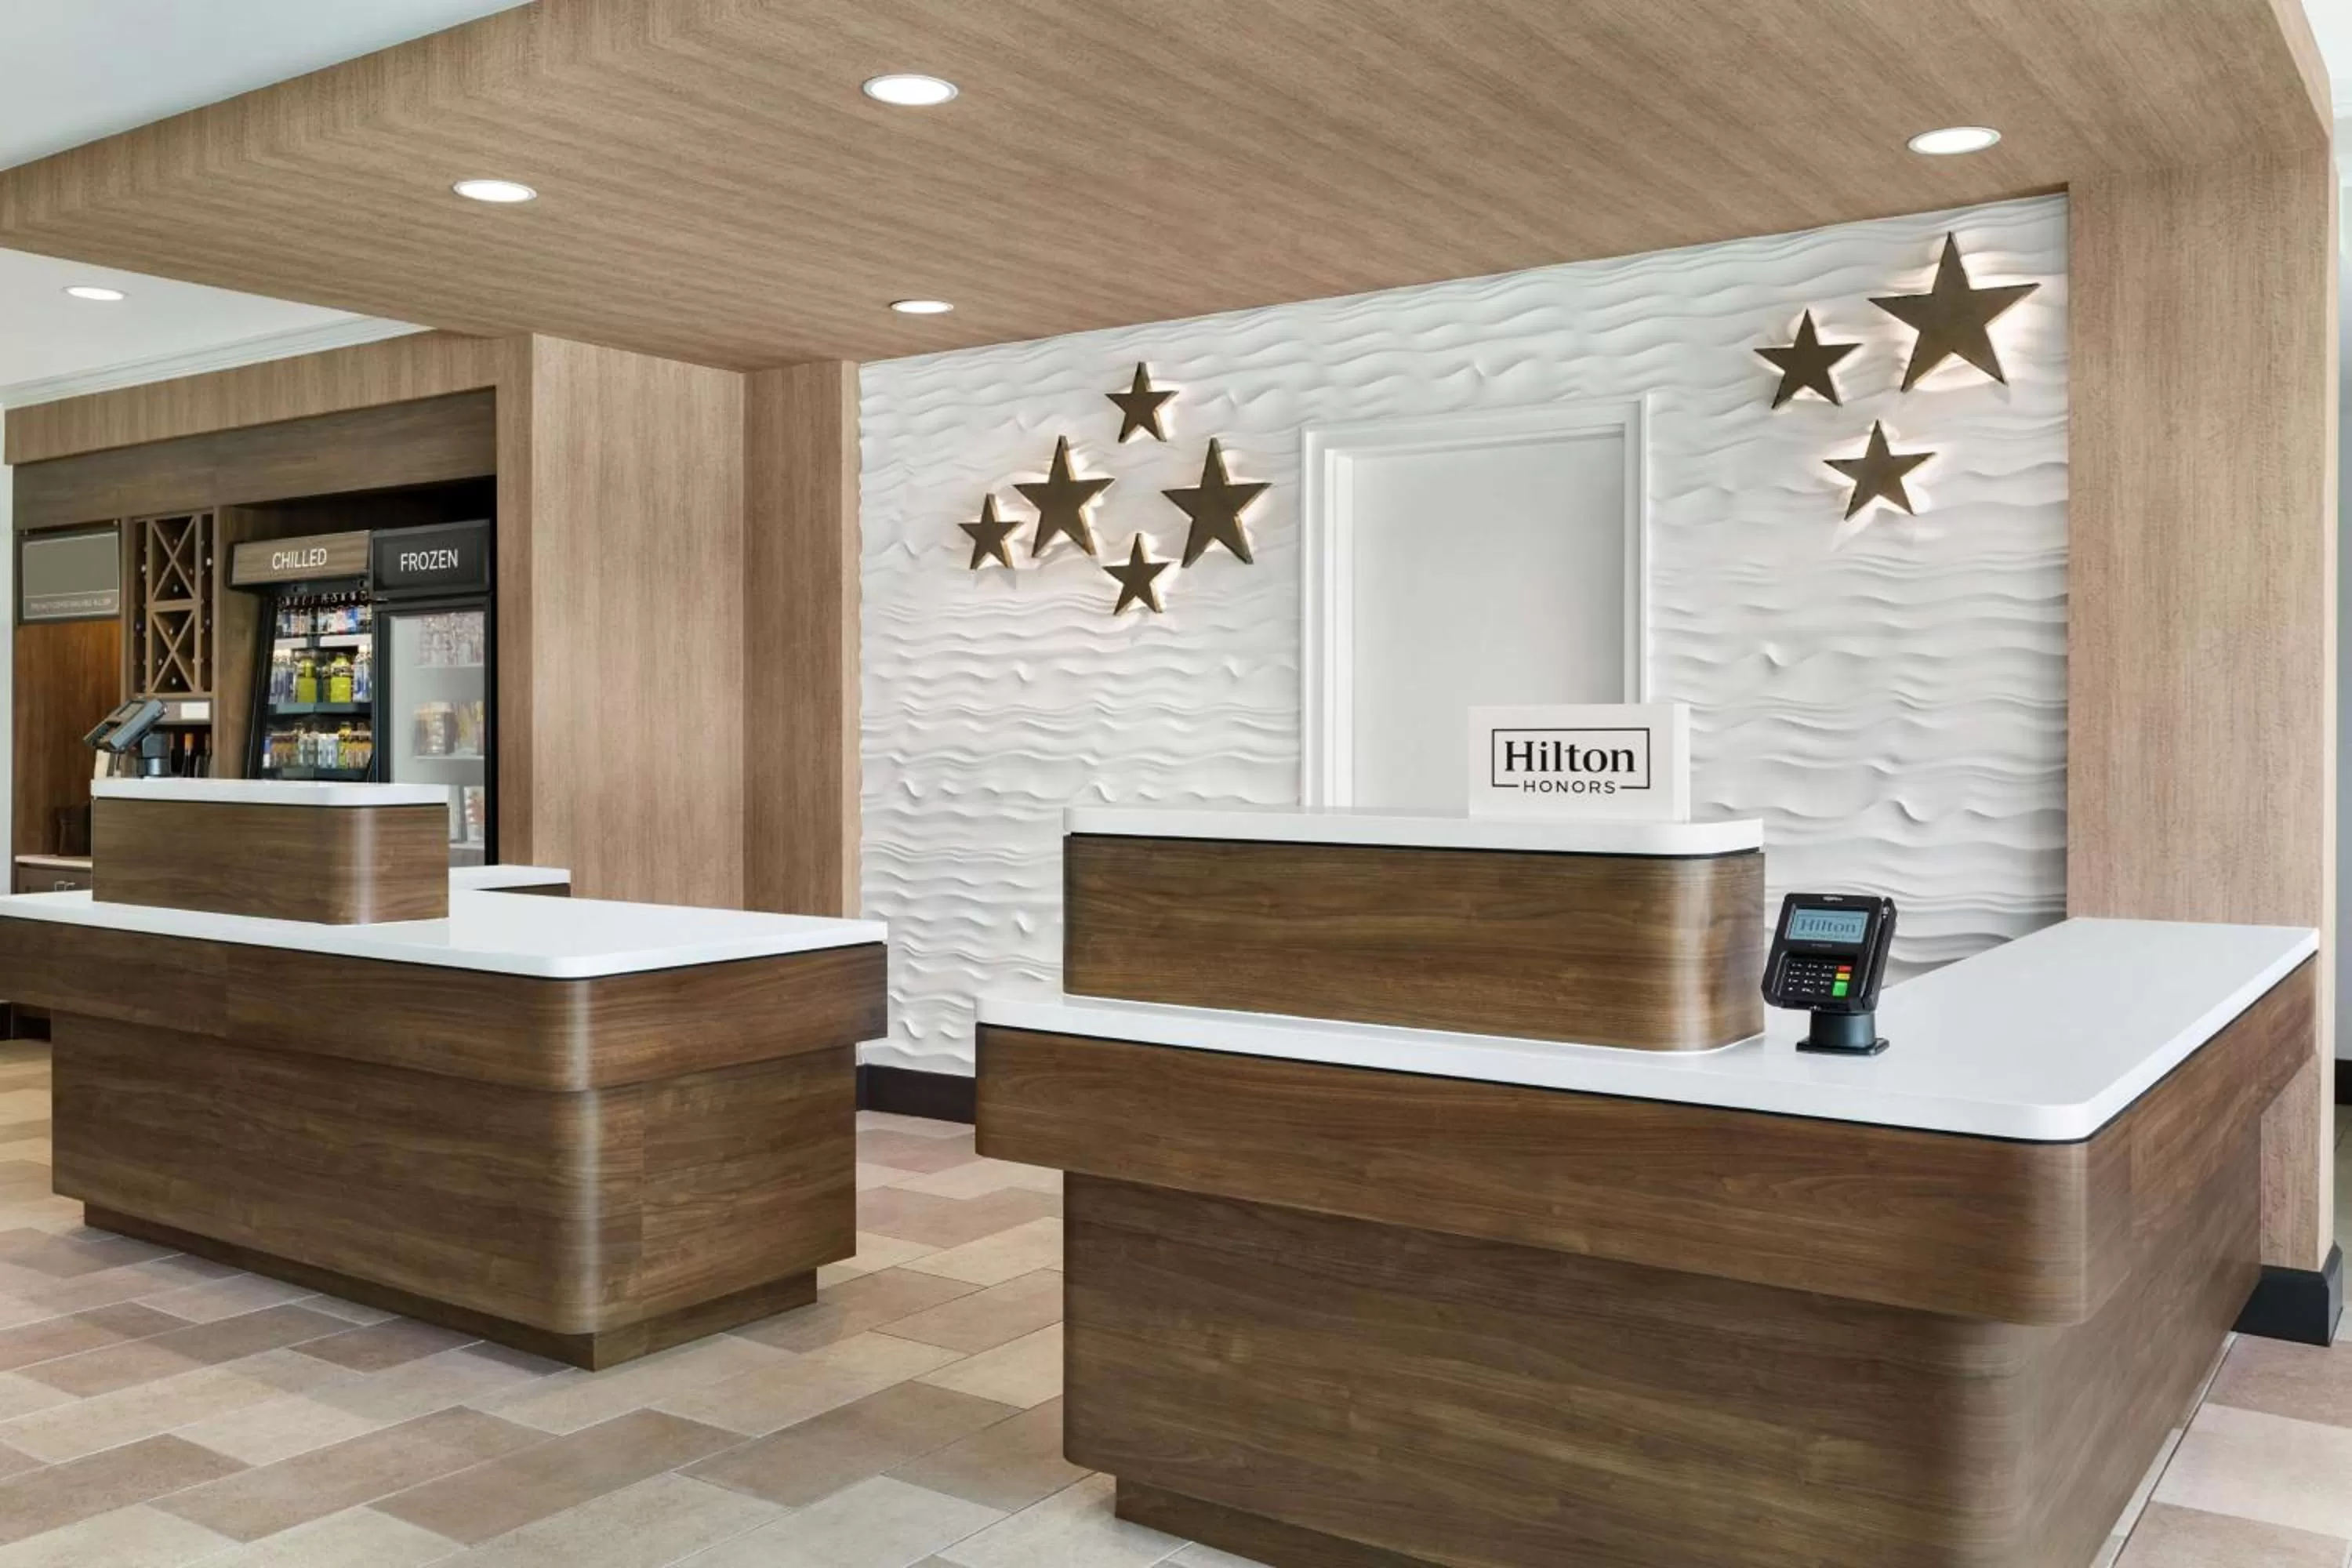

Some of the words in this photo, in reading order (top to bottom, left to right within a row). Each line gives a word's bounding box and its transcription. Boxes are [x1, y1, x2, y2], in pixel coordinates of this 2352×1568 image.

[272, 548, 327, 570] CHILLED
[401, 549, 459, 572] FROZEN
[1504, 741, 1636, 772] Hilton
[1523, 780, 1616, 794] HONORS
[1799, 918, 1857, 933] Hilton
